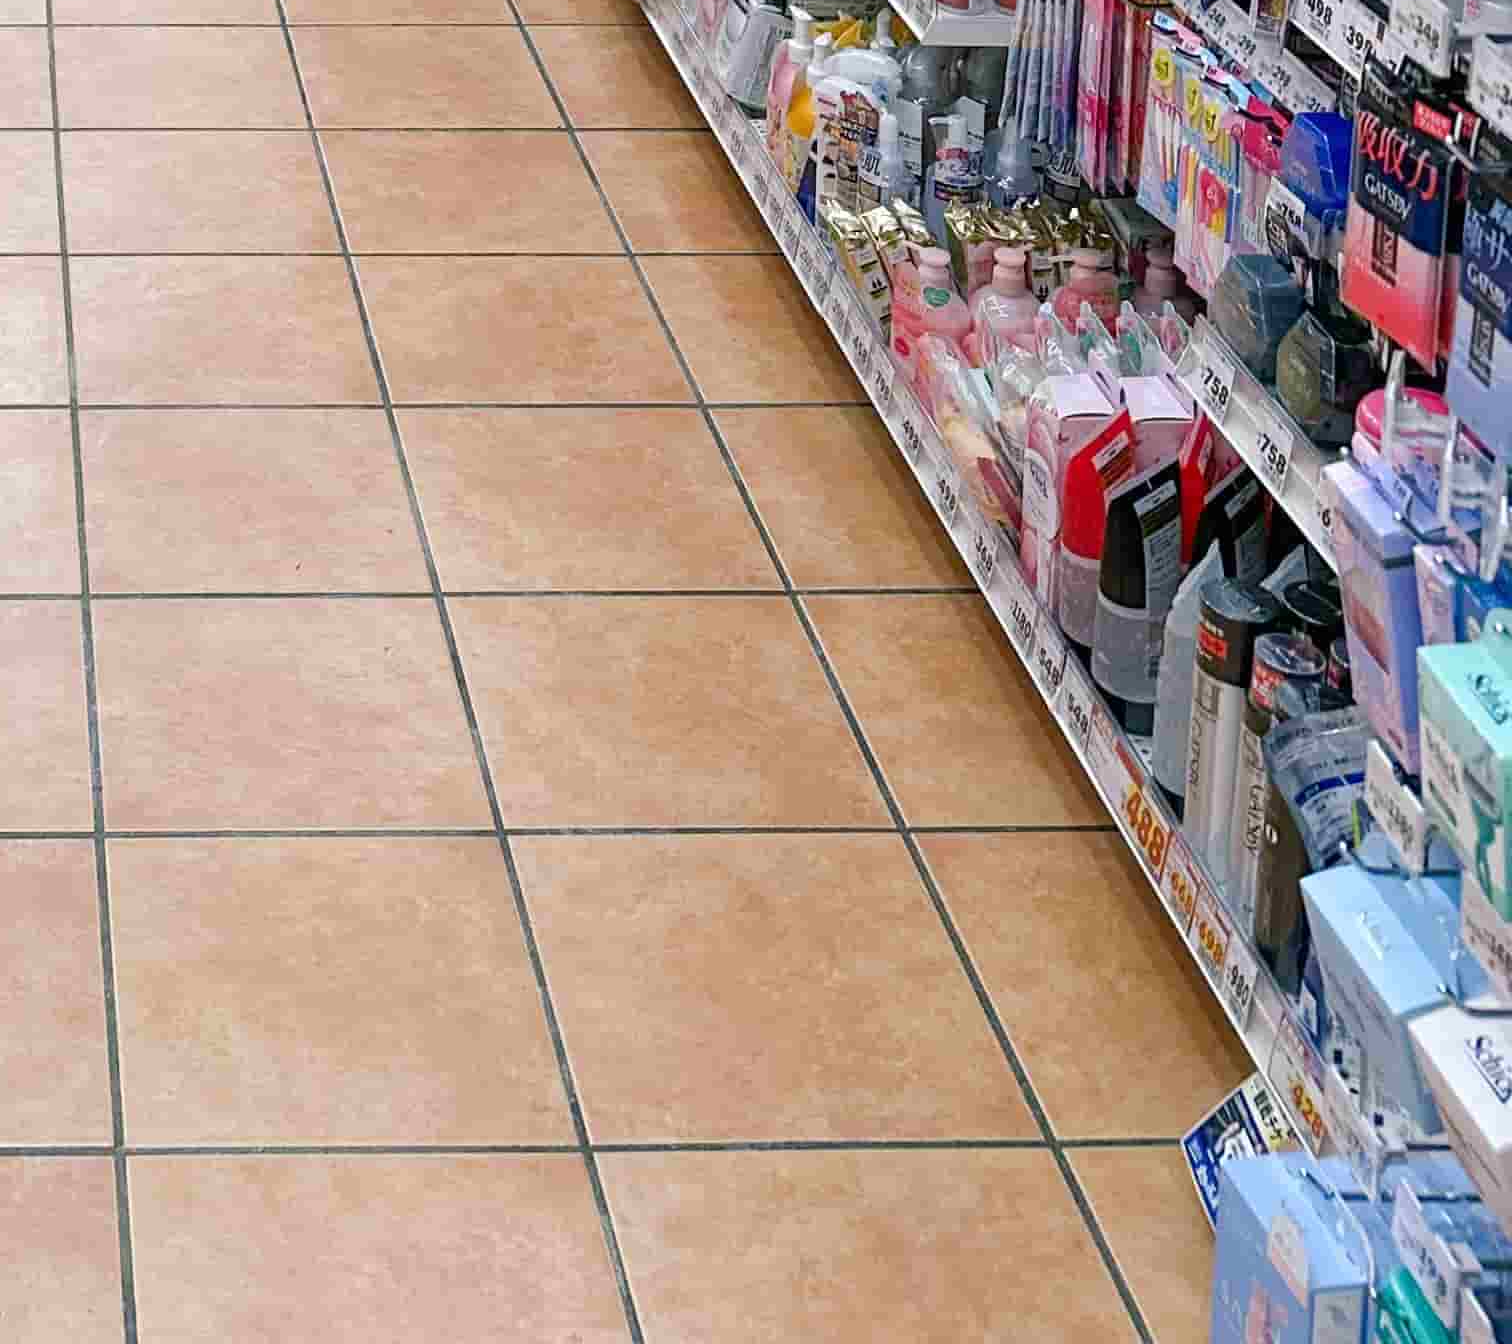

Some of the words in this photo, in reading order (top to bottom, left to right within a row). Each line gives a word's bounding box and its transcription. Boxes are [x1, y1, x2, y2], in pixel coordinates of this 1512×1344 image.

[1359, 112, 1437, 200] 吸収力
[1364, 172, 1410, 222] GATSBY
[1203, 368, 1229, 404] 758
[1261, 434, 1286, 475] 758
[1126, 788, 1166, 865] 488
[1229, 966, 1251, 1006] 980
